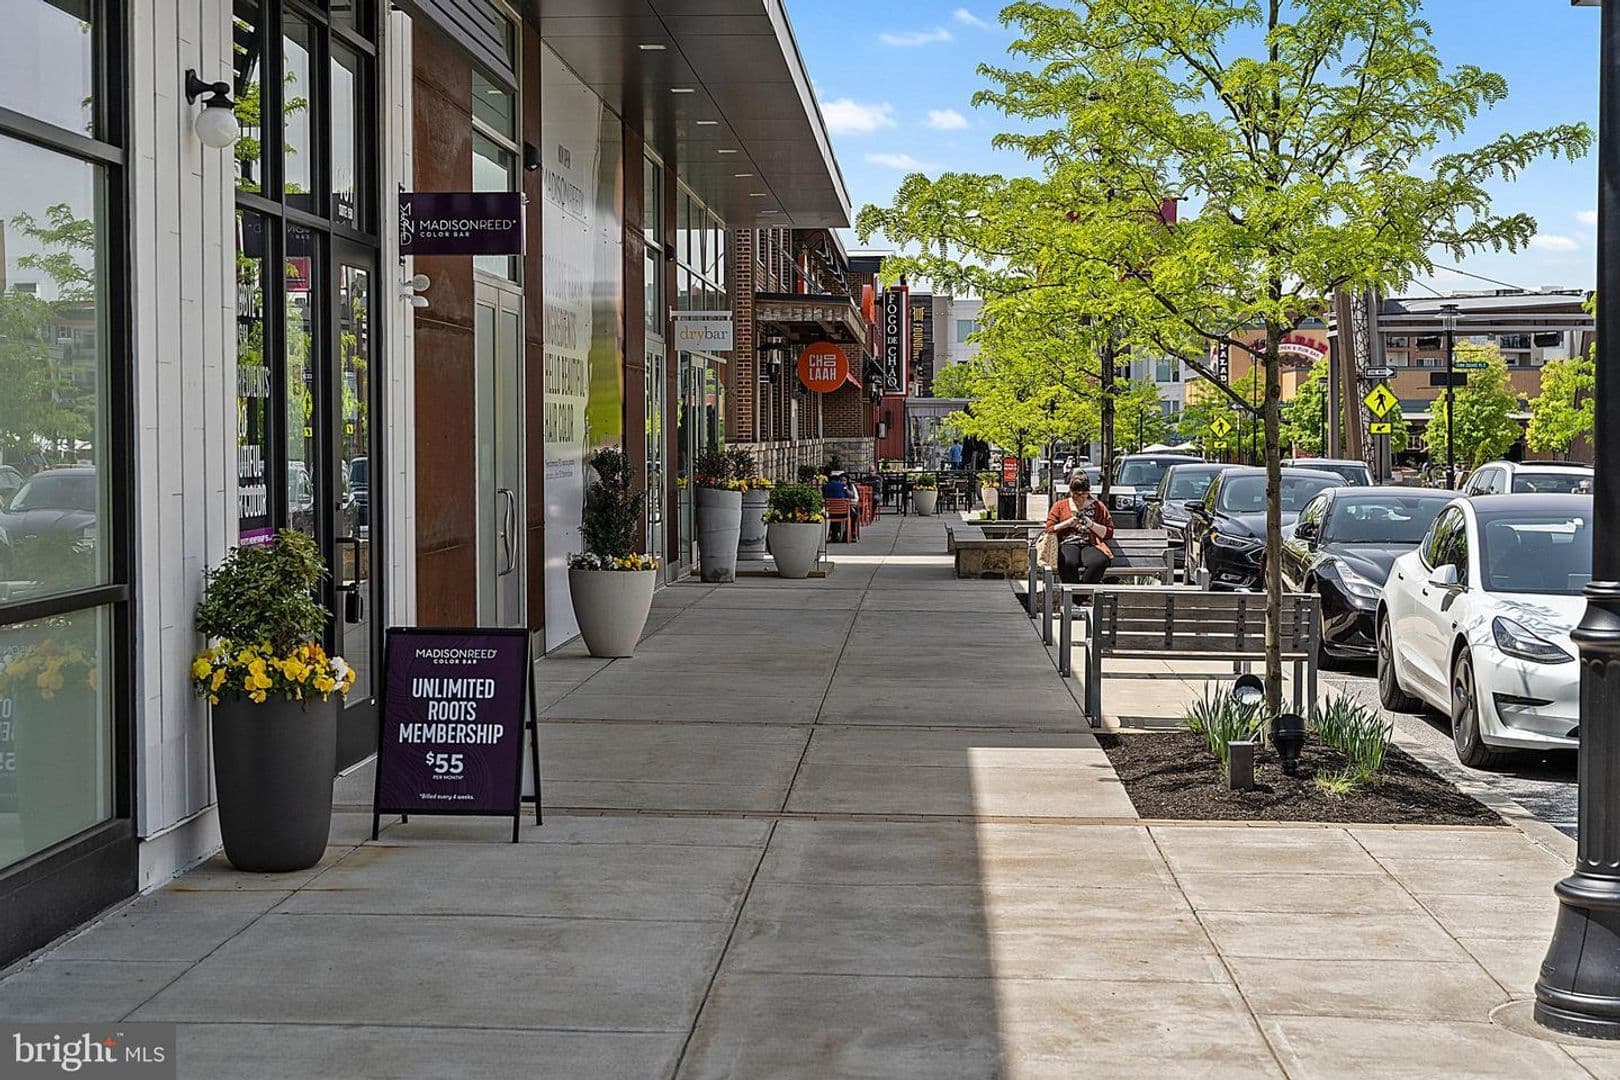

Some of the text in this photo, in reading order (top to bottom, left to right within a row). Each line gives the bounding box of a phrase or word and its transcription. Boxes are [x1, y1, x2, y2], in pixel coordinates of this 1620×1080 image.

[887, 294, 897, 335] FOGO
[680, 325, 729, 344] drybar
[808, 367, 837, 381] LAAH
[412, 678, 495, 700] UNLIMITED
[428, 701, 477, 721] ROOTS
[399, 723, 504, 745] MEMBERSHIP
[425, 750, 464, 774] $55
